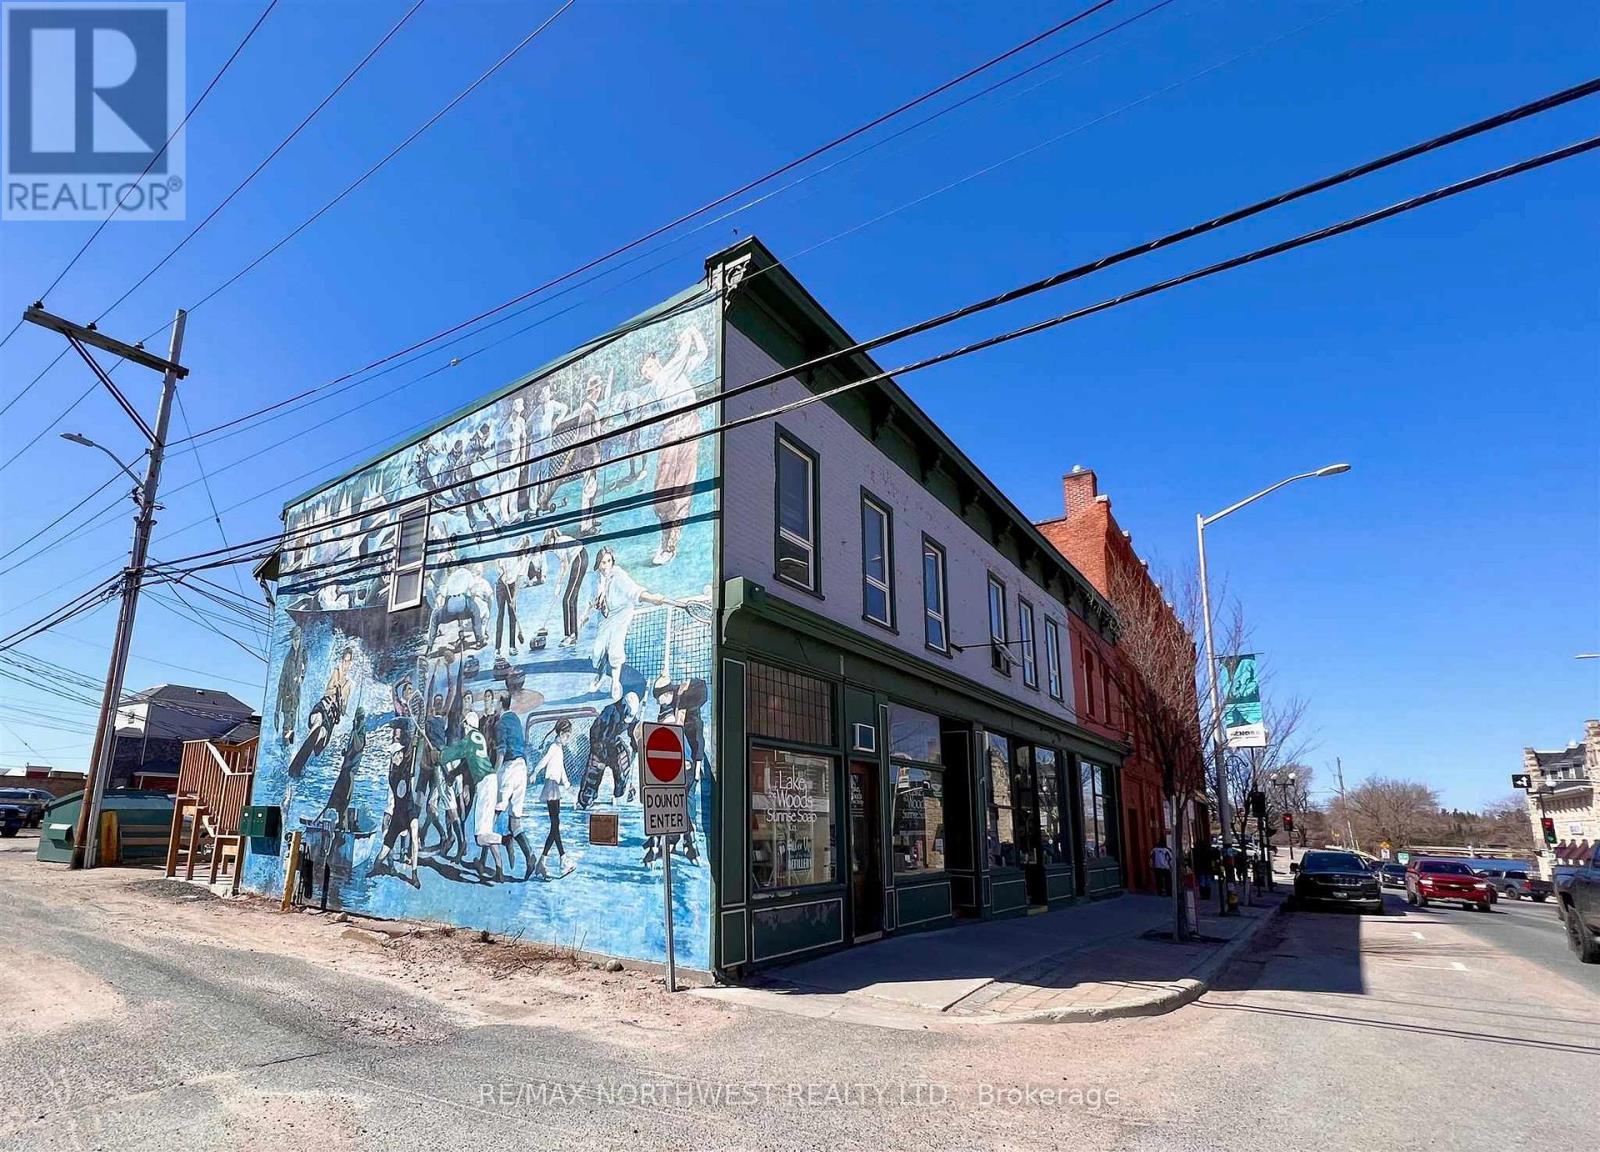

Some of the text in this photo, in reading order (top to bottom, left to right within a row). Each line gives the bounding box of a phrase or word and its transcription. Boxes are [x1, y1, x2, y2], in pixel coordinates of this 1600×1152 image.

[470, 731, 488, 758] 9
[779, 764, 805, 790] Lake
[776, 783, 813, 808] Woods
[650, 813, 683, 829] ENTER
[797, 809, 817, 823] Soap
